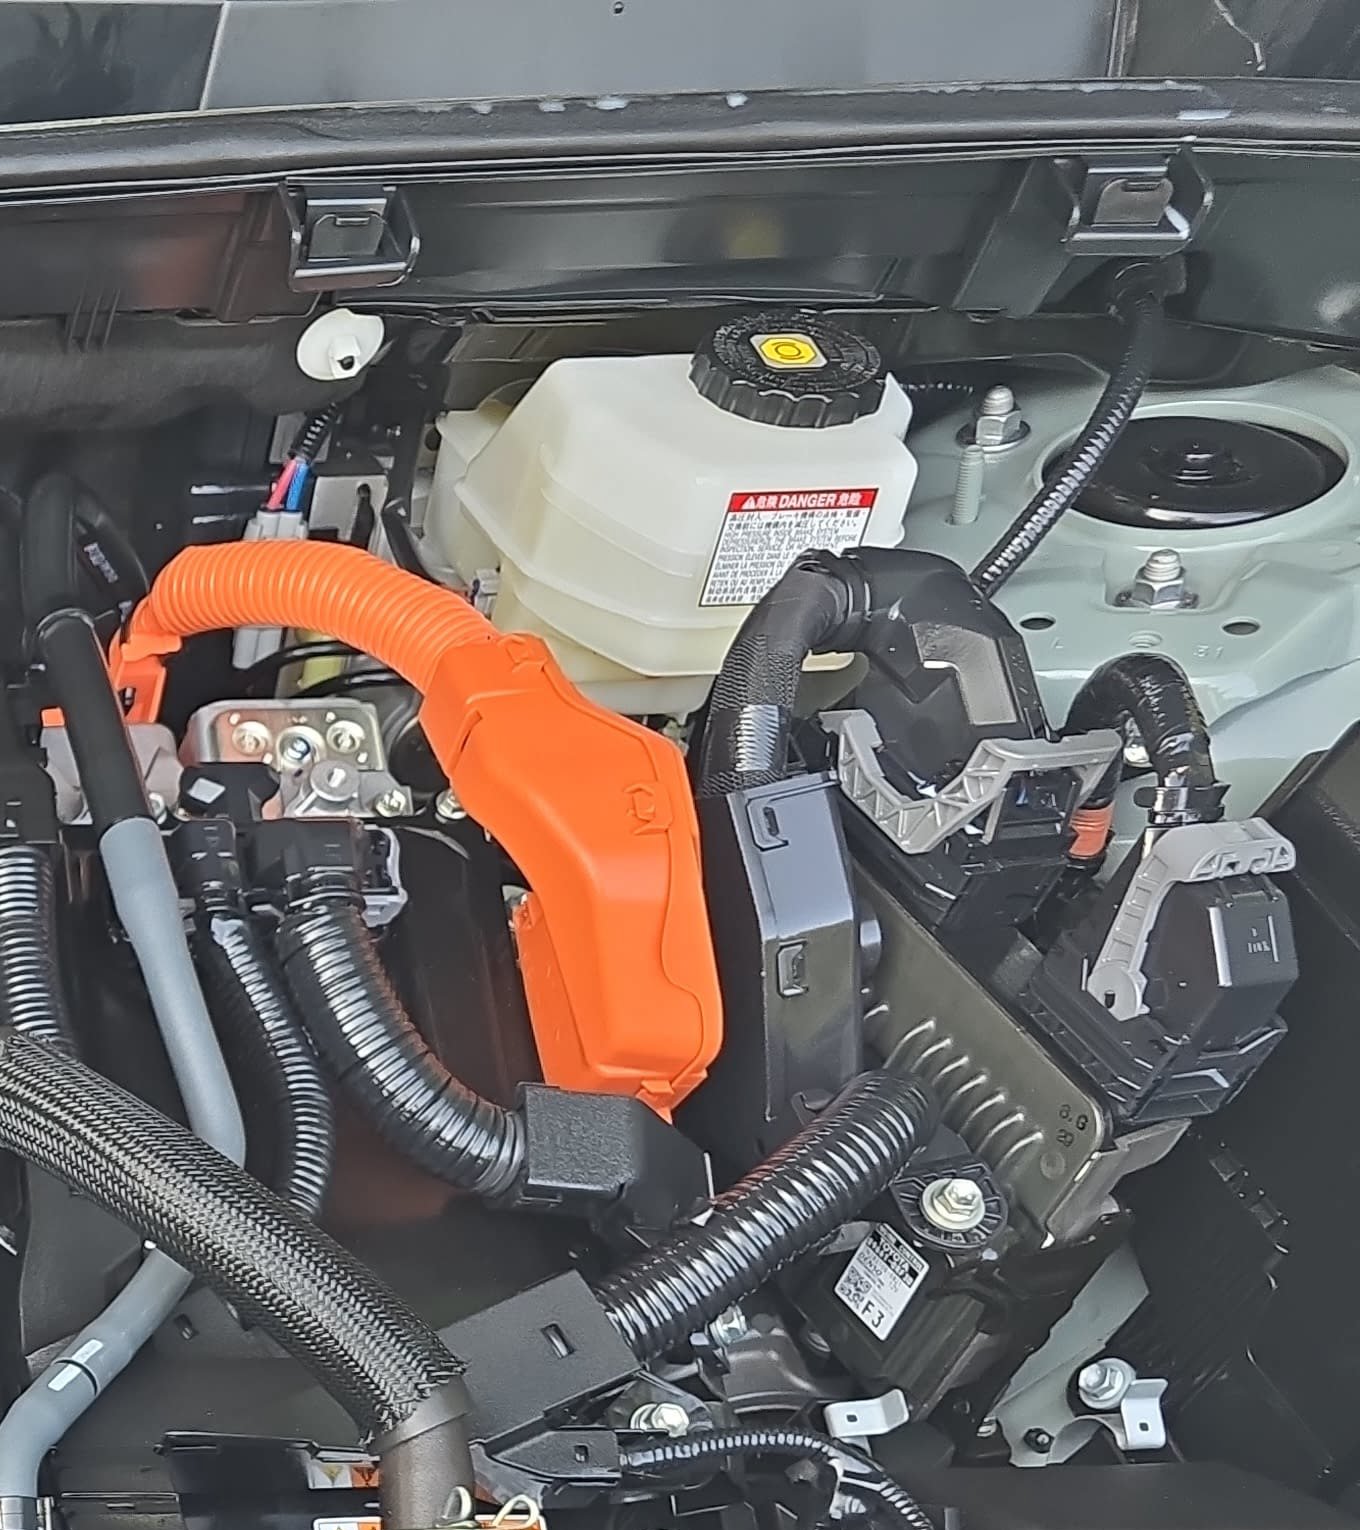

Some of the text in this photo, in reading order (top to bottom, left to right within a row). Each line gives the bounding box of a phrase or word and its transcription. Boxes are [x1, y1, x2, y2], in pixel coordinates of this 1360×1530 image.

[778, 492, 836, 508] DANGER
[877, 1237, 909, 1272] TOYOTA
[860, 1299, 876, 1315] F
[869, 1310, 885, 1328] 3
